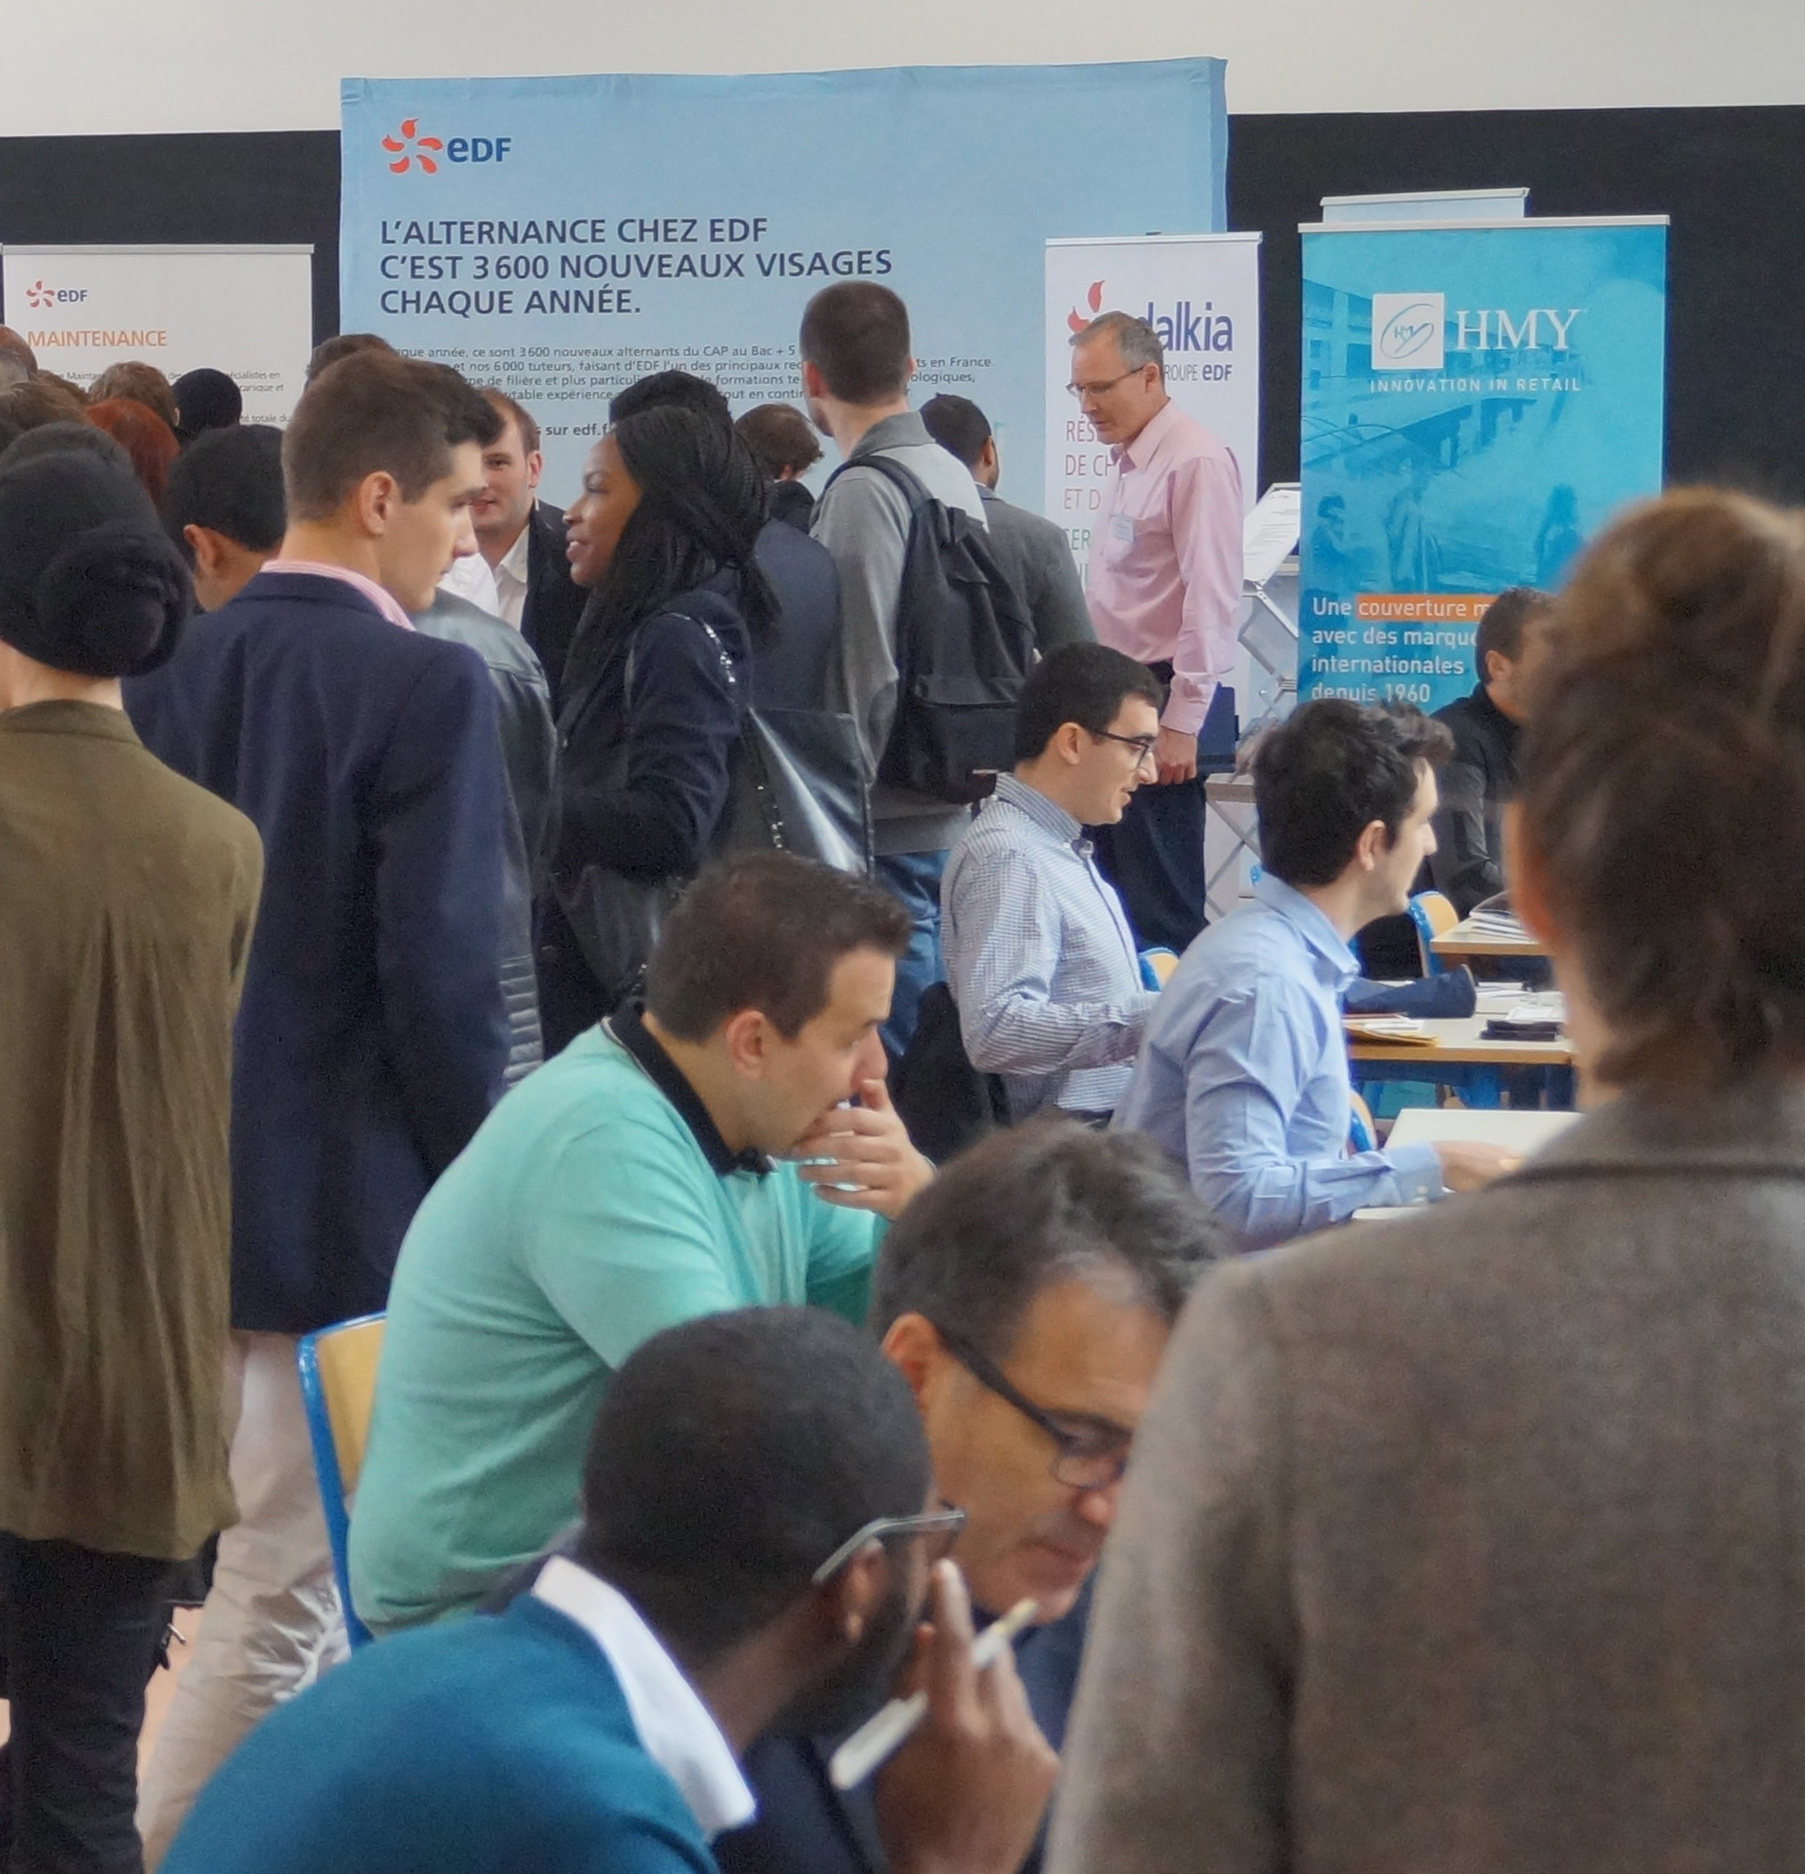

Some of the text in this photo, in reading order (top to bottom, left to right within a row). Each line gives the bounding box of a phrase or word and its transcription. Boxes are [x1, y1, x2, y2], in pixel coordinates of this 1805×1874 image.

[381, 217, 769, 246] L'ALTERNANCE CHEZ EDF
[380, 255, 465, 281] C'EST
[560, 253, 746, 279] NOUVEAUX
[755, 249, 893, 277] VISAGES
[380, 282, 642, 319] CHAQUE ANNÉE.
[28, 330, 168, 347] MAINTENANCE
[1455, 309, 1582, 351] HMY
[427, 347, 469, 359] année,
[472, 349, 486, 358] ce
[490, 348, 515, 358] sont
[554, 348, 614, 358] nouveaux
[617, 346, 680, 357] alternants
[683, 346, 700, 357] du
[703, 346, 729, 357] CAP
[732, 348, 748, 357] au
[751, 345, 772, 356] Bac
[788, 345, 796, 356] 5
[453, 362, 465, 372] et
[469, 363, 490, 372] nos
[528, 361, 575, 373] tuteurs,
[579, 360, 621, 371] faisant
[624, 360, 660, 371] d'EDF
[690, 360, 711, 371] des
[715, 360, 781, 373] principaux
[930, 359, 946, 368] en
[1163, 364, 1198, 381] ROUPE
[487, 375, 502, 385] de
[506, 375, 542, 385] filière
[545, 376, 558, 385] et
[561, 375, 586, 387] plus
[715, 374, 784, 385] formations
[910, 372, 976, 384] ologiques,
[1370, 376, 1582, 394] INNOVATION IN RETAIL
[749, 390, 764, 399] en
[545, 427, 569, 436] sur
[573, 423, 608, 437] edf.f
[1065, 454, 1088, 477] DE
[1063, 488, 1083, 510] ET
[1312, 597, 1352, 617] Une
[1358, 599, 1467, 618] couverture
[1312, 629, 1357, 645] avec
[1363, 626, 1398, 645] des
[1311, 654, 1464, 675] internationales
[1385, 683, 1431, 703] 1960
